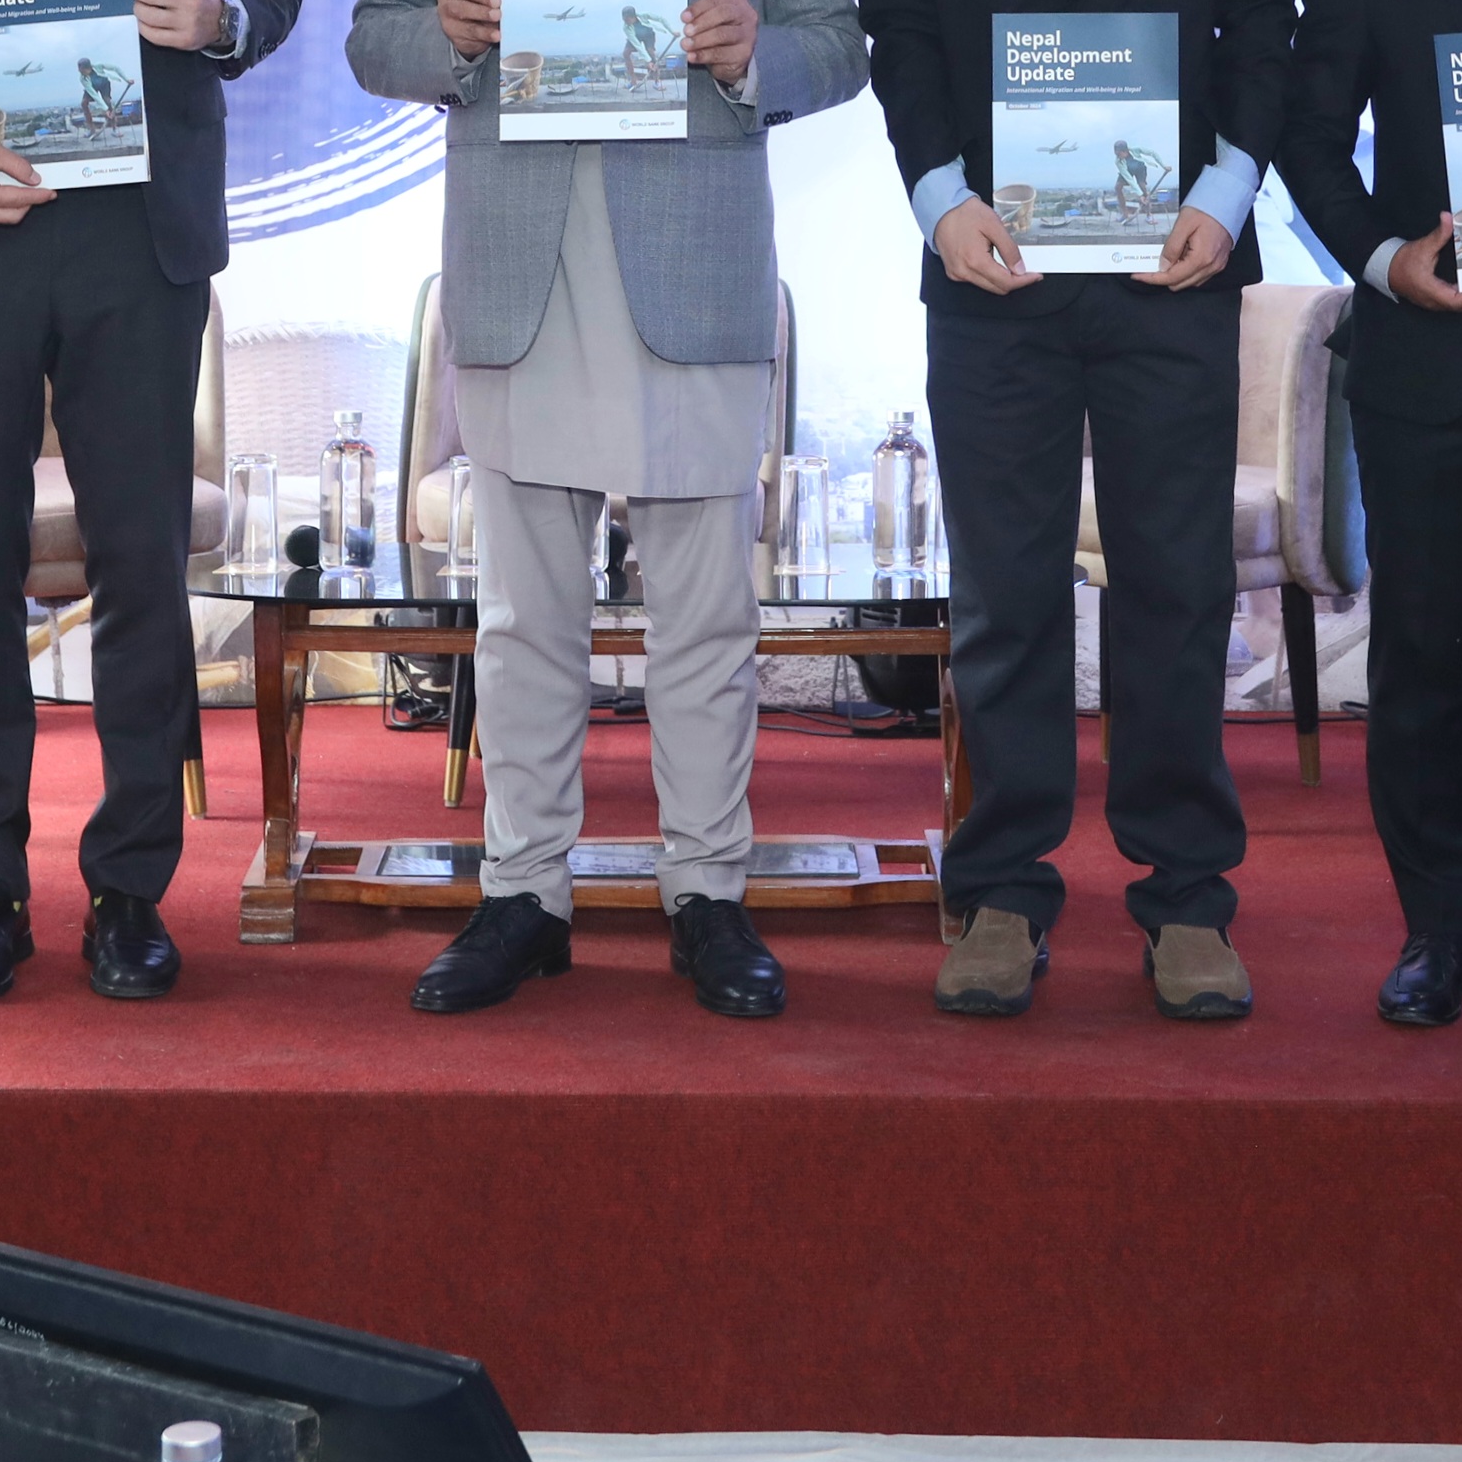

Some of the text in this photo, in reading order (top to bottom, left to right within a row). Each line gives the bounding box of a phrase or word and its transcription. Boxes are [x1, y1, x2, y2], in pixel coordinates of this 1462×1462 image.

[7, 10, 34, 18] Migration
[1006, 30, 1061, 50] Nepal
[1006, 47, 1132, 67] Development
[1006, 65, 1075, 85] Update
